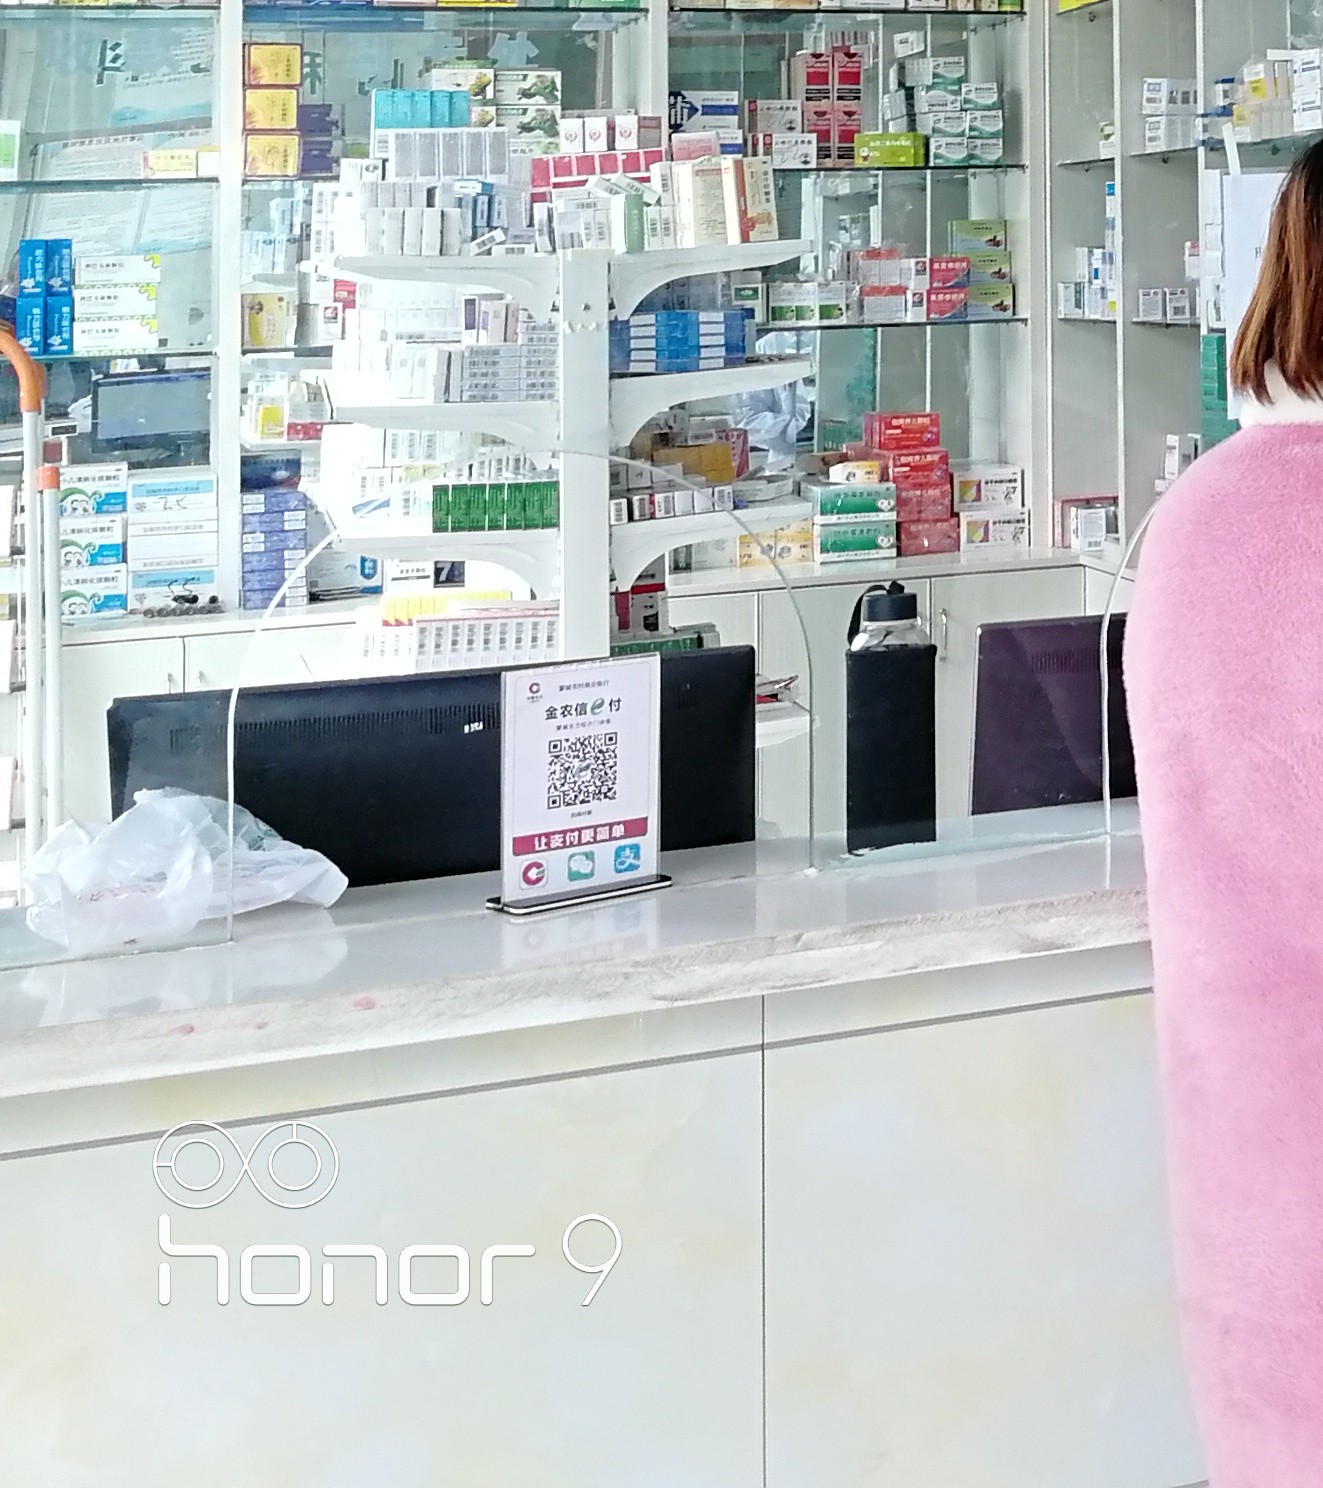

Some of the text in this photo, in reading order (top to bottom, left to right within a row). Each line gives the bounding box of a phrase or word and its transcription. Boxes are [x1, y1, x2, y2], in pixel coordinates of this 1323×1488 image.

[534, 823, 626, 851] 让支付更简单
